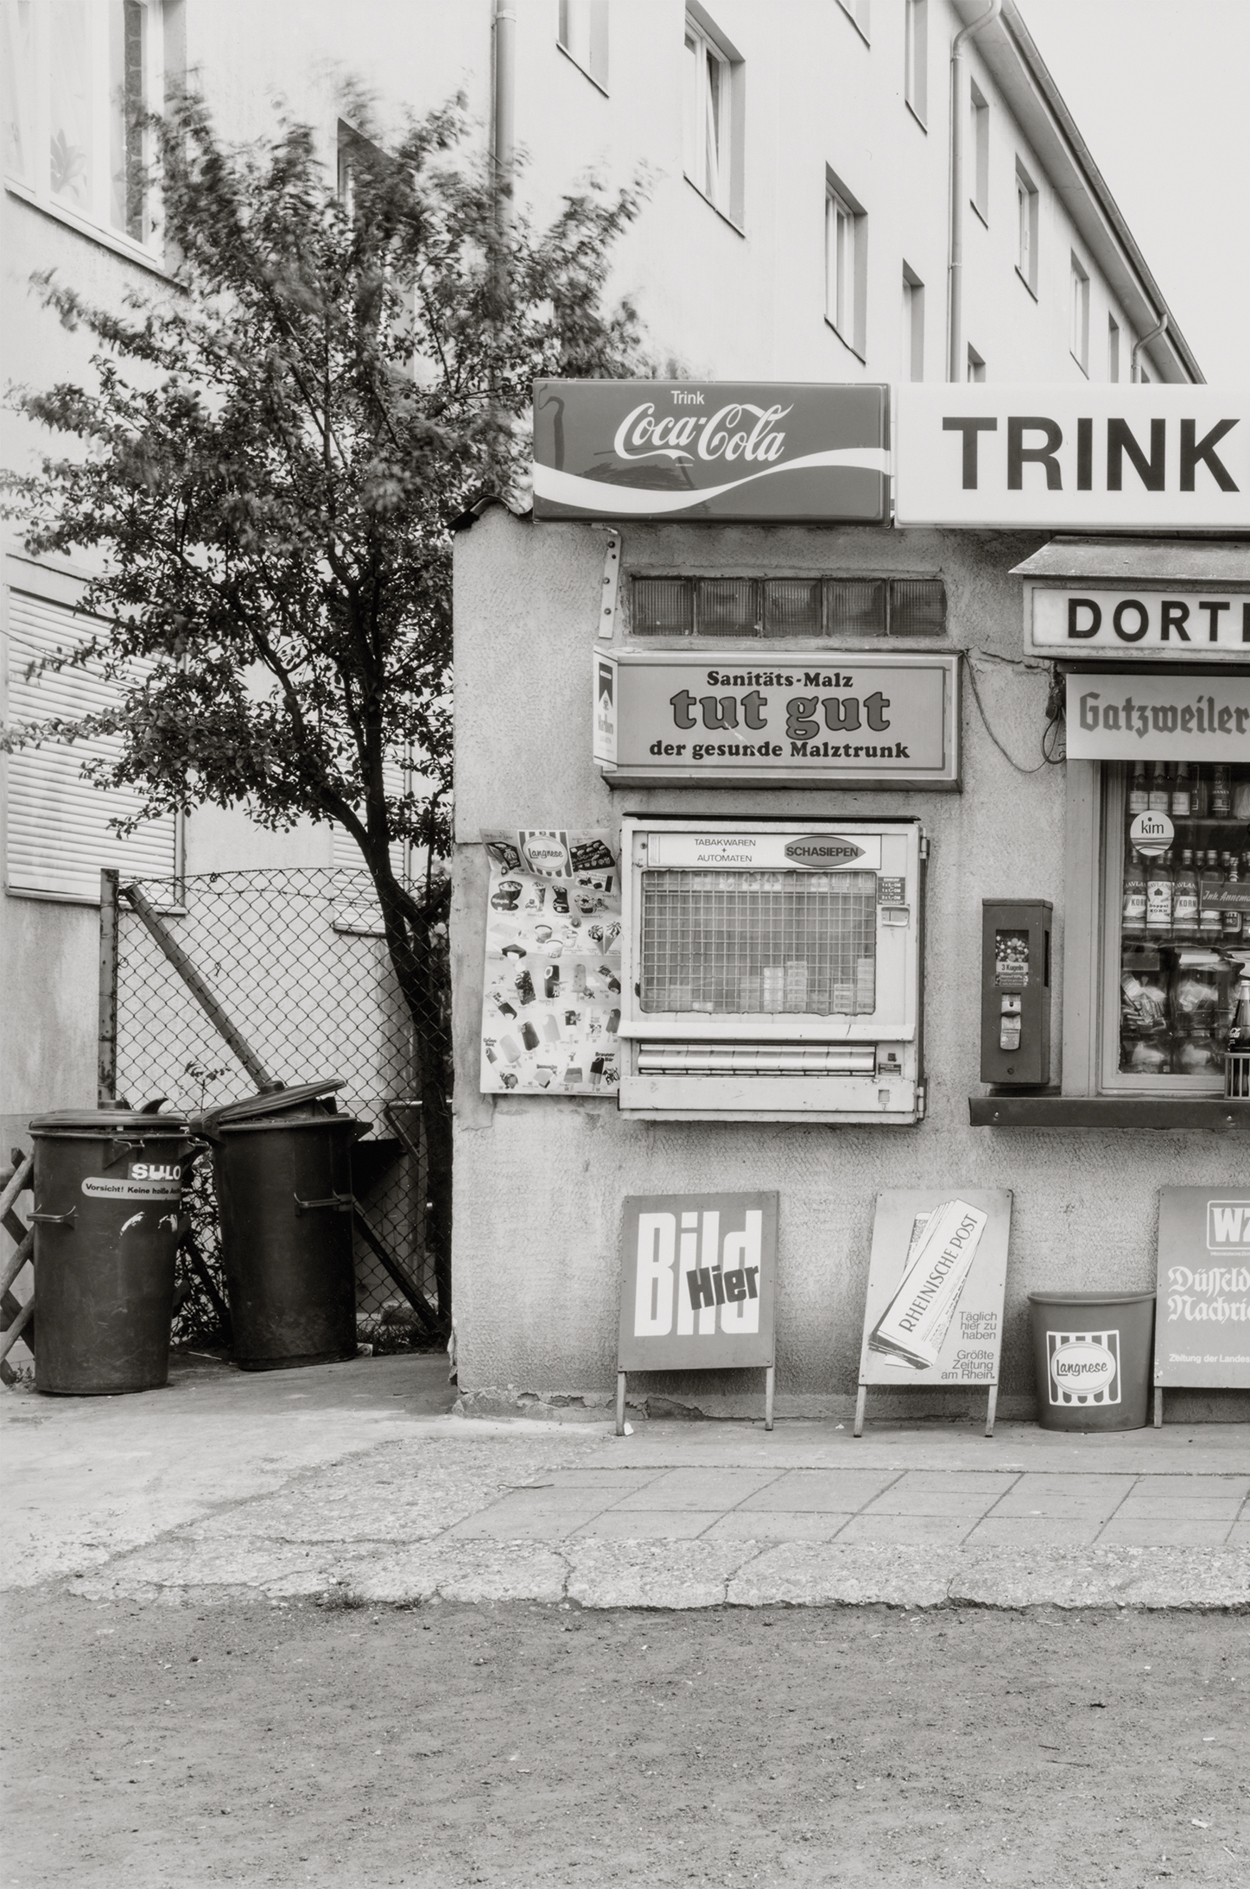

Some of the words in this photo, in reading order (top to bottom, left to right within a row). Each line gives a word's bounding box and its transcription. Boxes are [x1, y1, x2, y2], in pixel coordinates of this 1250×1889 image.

[671, 390, 705, 406] Trink
[613, 402, 794, 462] Coca-Cola
[706, 670, 854, 689] Sanitäts-Malz
[670, 689, 769, 731] tut
[786, 690, 891, 740] gut
[649, 739, 687, 757] der
[692, 739, 783, 760] gesunde
[789, 741, 911, 759] Malztrunk
[1141, 816, 1164, 835] kim
[694, 838, 756, 847] TABAKWAREN
[528, 848, 564, 859] Langnese
[697, 854, 753, 863] AUTOMATEN
[786, 846, 859, 858] SCHASIEPEN
[1203, 890, 1219, 901] Inh.
[1179, 899, 1197, 907] KORN
[1006, 964, 1024, 973] Kugeln
[86, 1183, 124, 1193] Vorsicht!
[634, 1210, 763, 1337] Bild
[898, 1246, 960, 1334] RHEINISCHE
[950, 1213, 979, 1255] POST
[686, 1264, 760, 1311] Hier
[958, 1310, 998, 1324] Täglich
[960, 1321, 980, 1331] hier
[985, 1323, 997, 1331] zu
[962, 1330, 997, 1341] haben
[956, 1349, 994, 1362] Größte
[1169, 1353, 1202, 1365] Zeitung
[1203, 1354, 1218, 1364] der
[952, 1359, 994, 1373] Zeitung
[1056, 1359, 1108, 1377] Langnese
[940, 1371, 958, 1380] am
